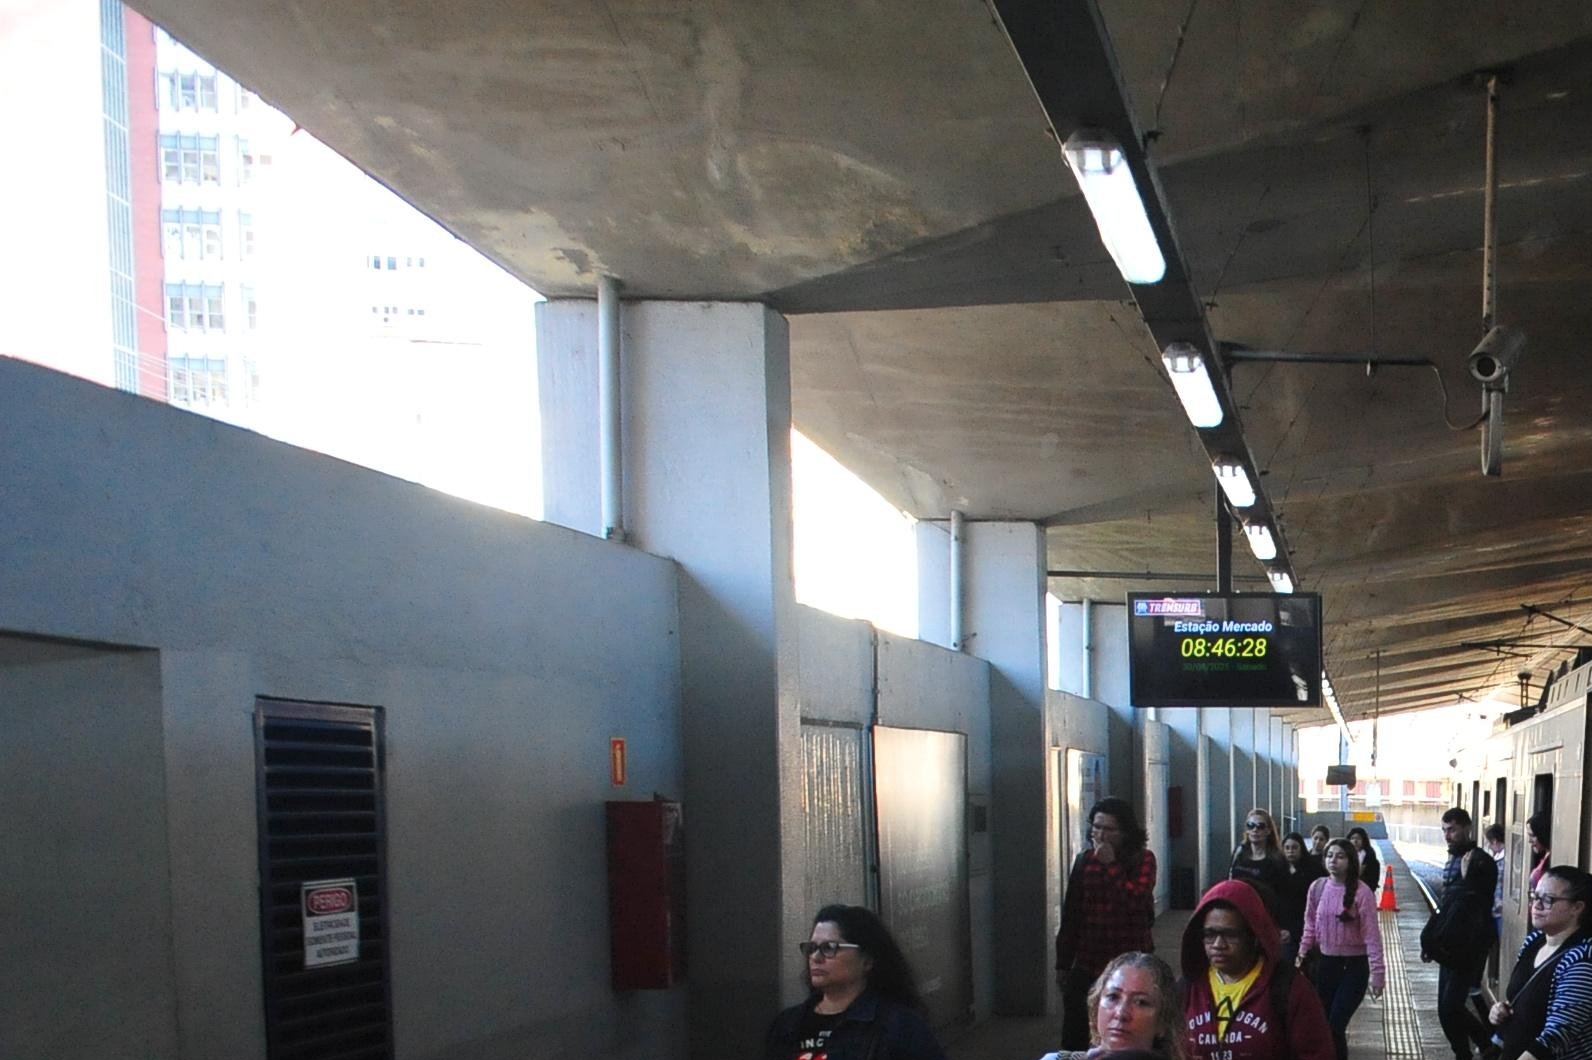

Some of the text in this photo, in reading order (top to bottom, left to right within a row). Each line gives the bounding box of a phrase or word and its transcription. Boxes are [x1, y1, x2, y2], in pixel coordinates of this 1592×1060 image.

[1174, 620, 1273, 634] Estação Mercado
[1181, 638, 1267, 657] 08:46:28
